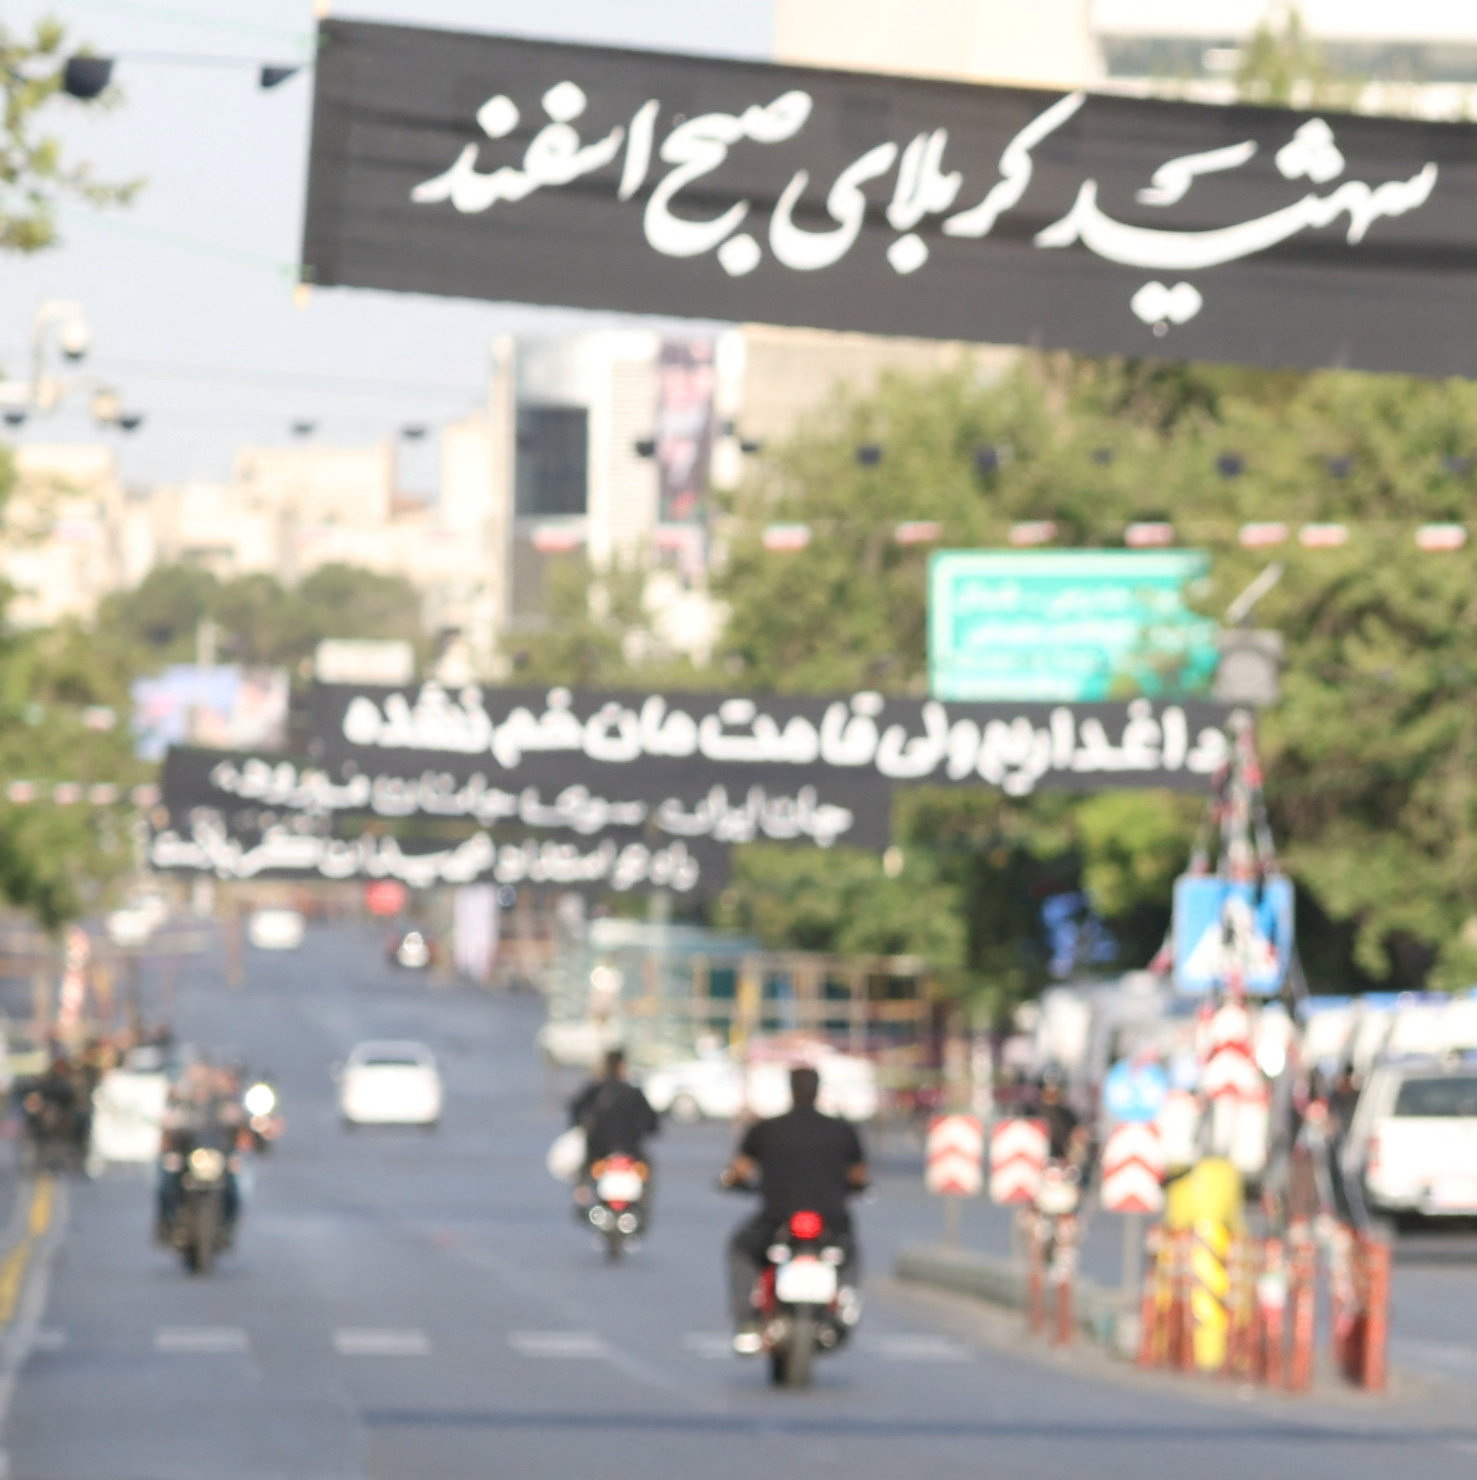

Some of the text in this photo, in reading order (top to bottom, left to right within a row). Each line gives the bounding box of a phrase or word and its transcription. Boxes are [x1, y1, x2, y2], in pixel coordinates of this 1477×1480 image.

[411, 80, 659, 213] اسفند
[644, 90, 813, 276] صبح
[769, 90, 1086, 275] کربلای
[1034, 118, 1438, 325] شهید
[343, 680, 494, 754] نشده
[490, 687, 583, 768] خم
[876, 701, 981, 780] ولی
[976, 698, 1228, 797] داغداریم
